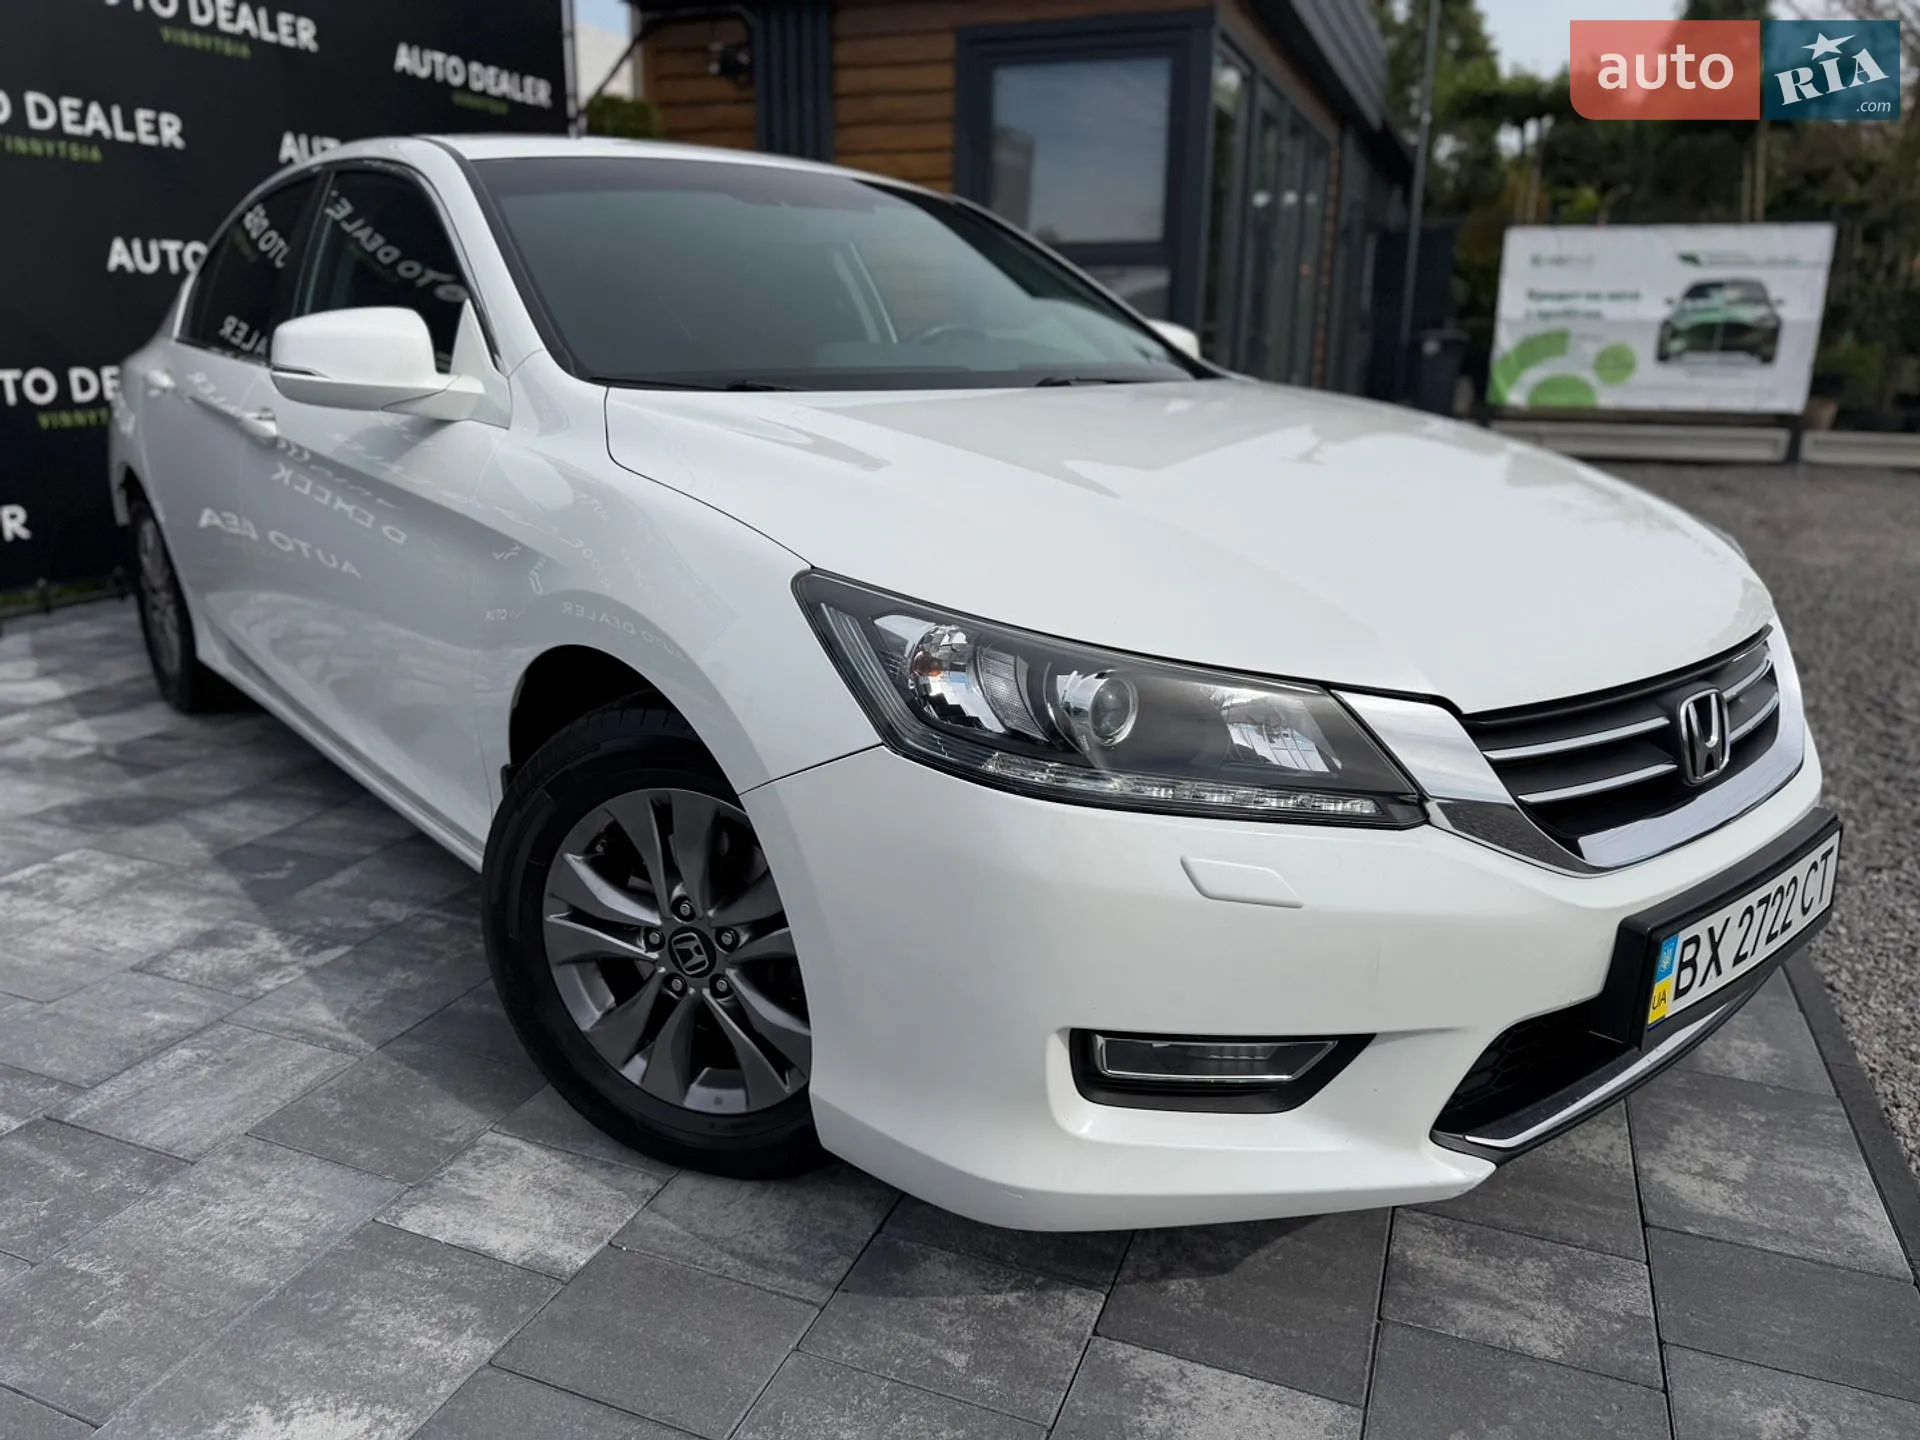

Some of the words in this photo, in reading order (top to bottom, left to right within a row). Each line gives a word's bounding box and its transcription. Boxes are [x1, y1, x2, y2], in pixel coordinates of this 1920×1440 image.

[187, 0, 318, 52] DEALER
[393, 42, 467, 87] AUTO
[467, 60, 553, 109] DEALER
[24, 90, 187, 150] DEALER
[0, 135, 103, 162] INNYTSIA
[1673, 917, 1731, 1001] BX
[1732, 875, 1798, 968] 2722
[1801, 846, 1835, 917] CT
[1651, 989, 1668, 1010] UA
